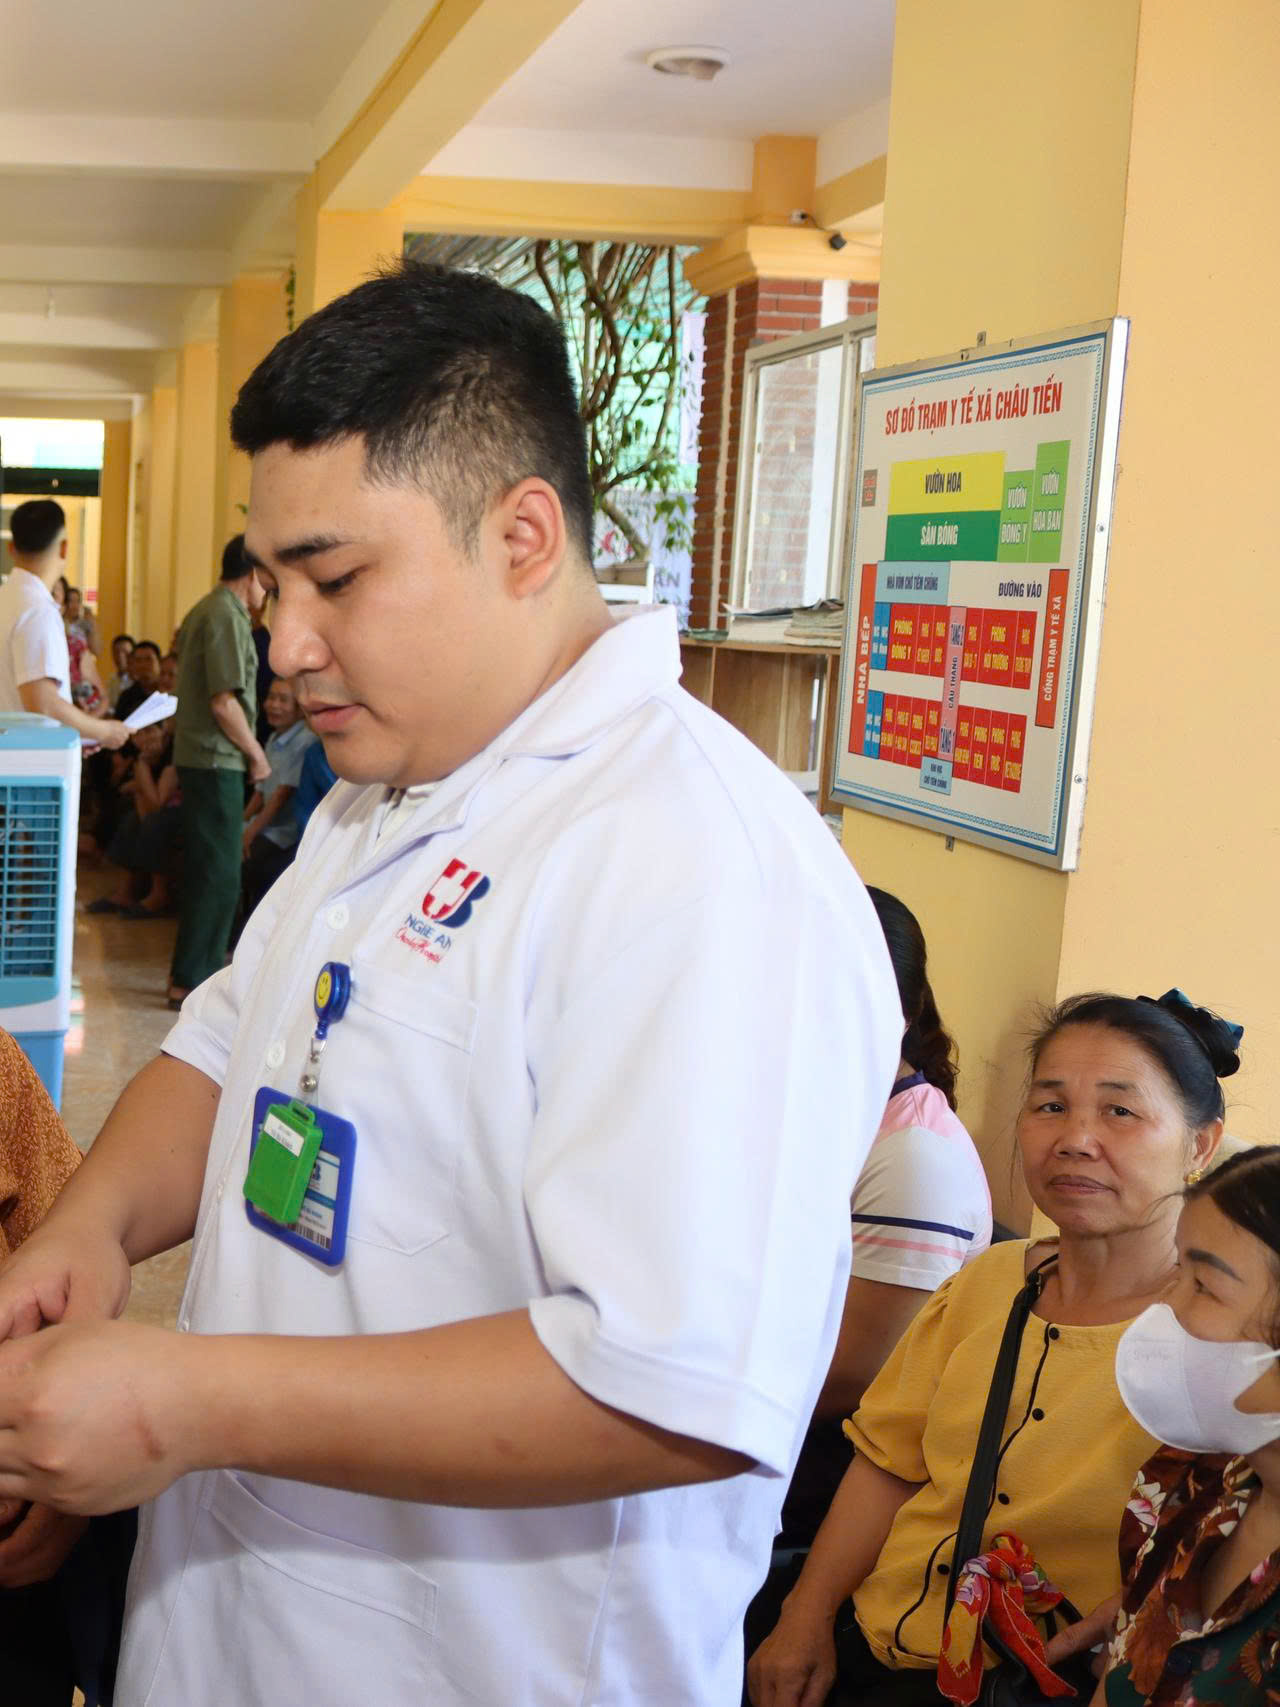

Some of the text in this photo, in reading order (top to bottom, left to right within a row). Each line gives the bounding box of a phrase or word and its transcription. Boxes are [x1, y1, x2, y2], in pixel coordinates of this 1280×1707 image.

[885, 406, 900, 435] SƠ
[918, 400, 948, 435] TRẠM
[951, 399, 958, 426] Y
[960, 386, 976, 425] TẾ
[976, 387, 992, 422] XÃ
[995, 383, 1030, 420] CHÂU
[1032, 373, 1063, 416] TIẾN
[946, 472, 962, 493] HOA
[920, 520, 959, 545] SÂN BÓNG
[1026, 580, 1042, 598] VÀO
